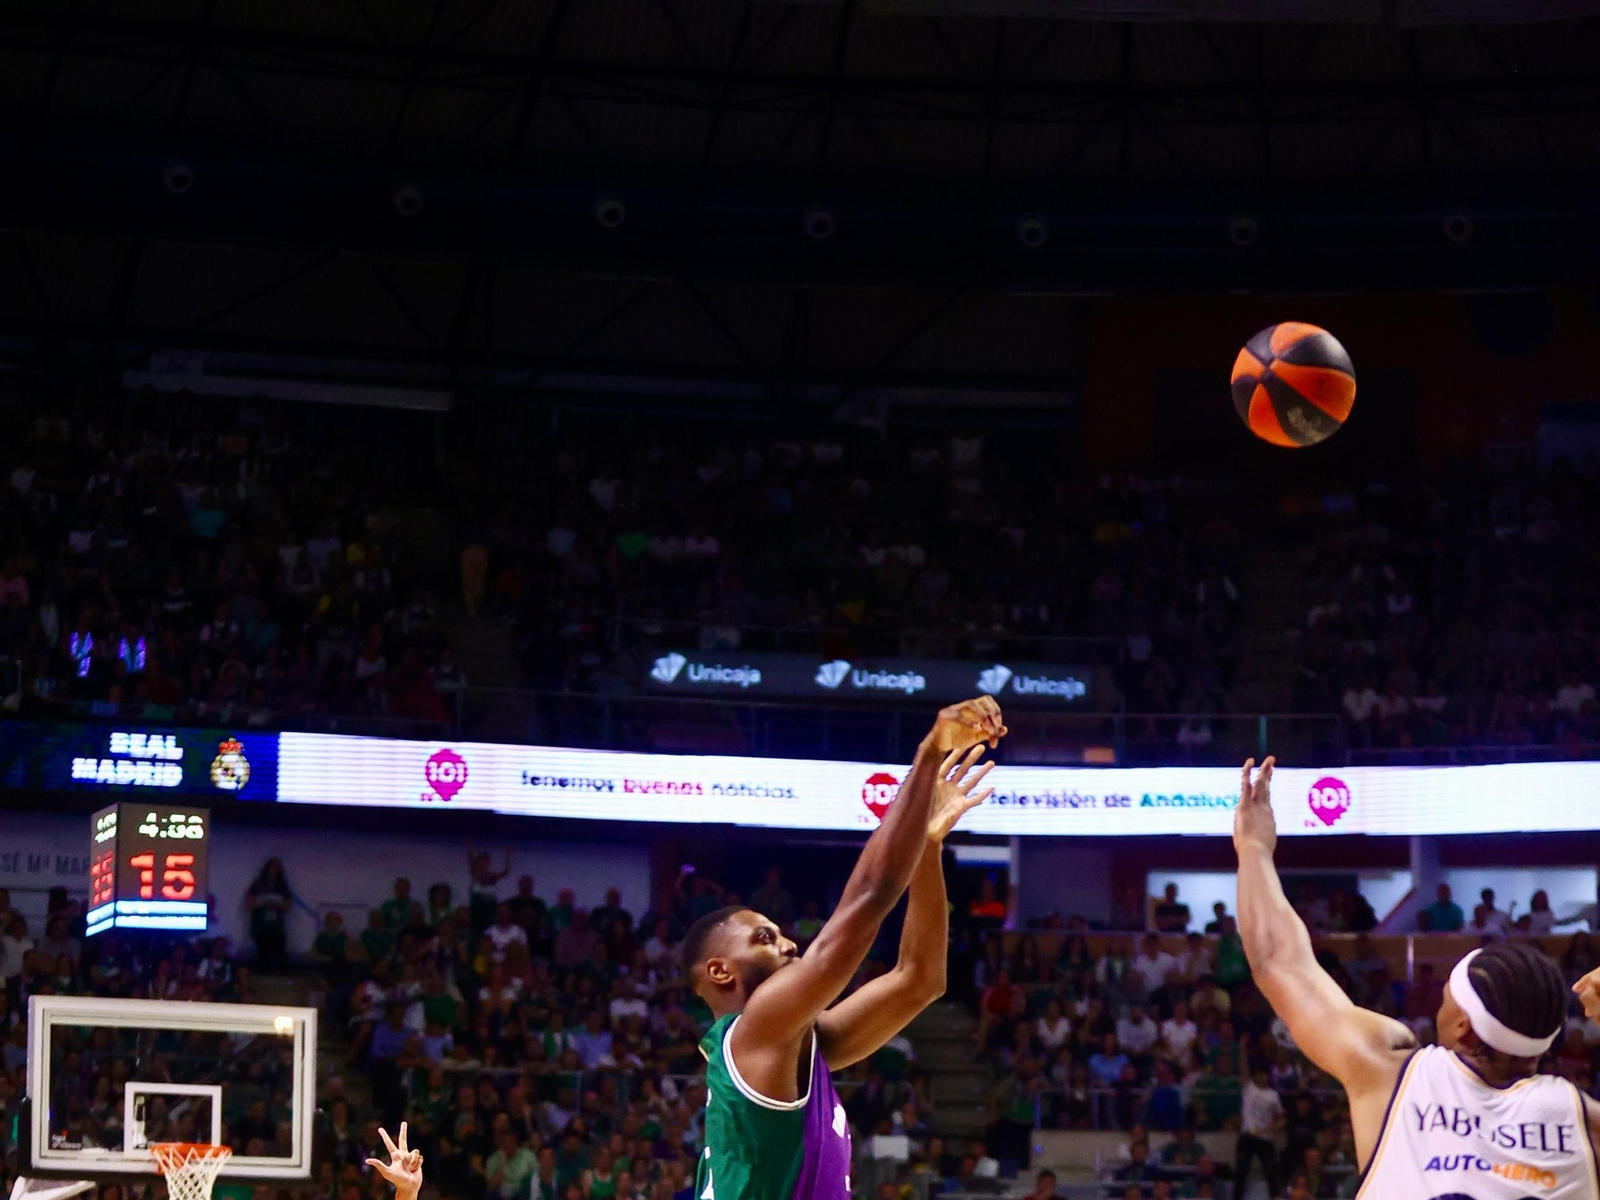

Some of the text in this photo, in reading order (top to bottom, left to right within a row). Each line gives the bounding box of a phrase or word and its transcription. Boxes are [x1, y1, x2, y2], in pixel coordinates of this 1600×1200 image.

[688, 663, 761, 688] Unicaja
[853, 670, 926, 694] Unicaja
[1013, 675, 1086, 699] Unicaja
[72, 758, 183, 787] MADRID
[426, 761, 468, 783] 101
[521, 770, 614, 793] tenemos
[624, 778, 704, 796] buenas
[1104, 792, 1132, 808] de
[1309, 787, 1351, 810] 101
[130, 851, 195, 900] 15
